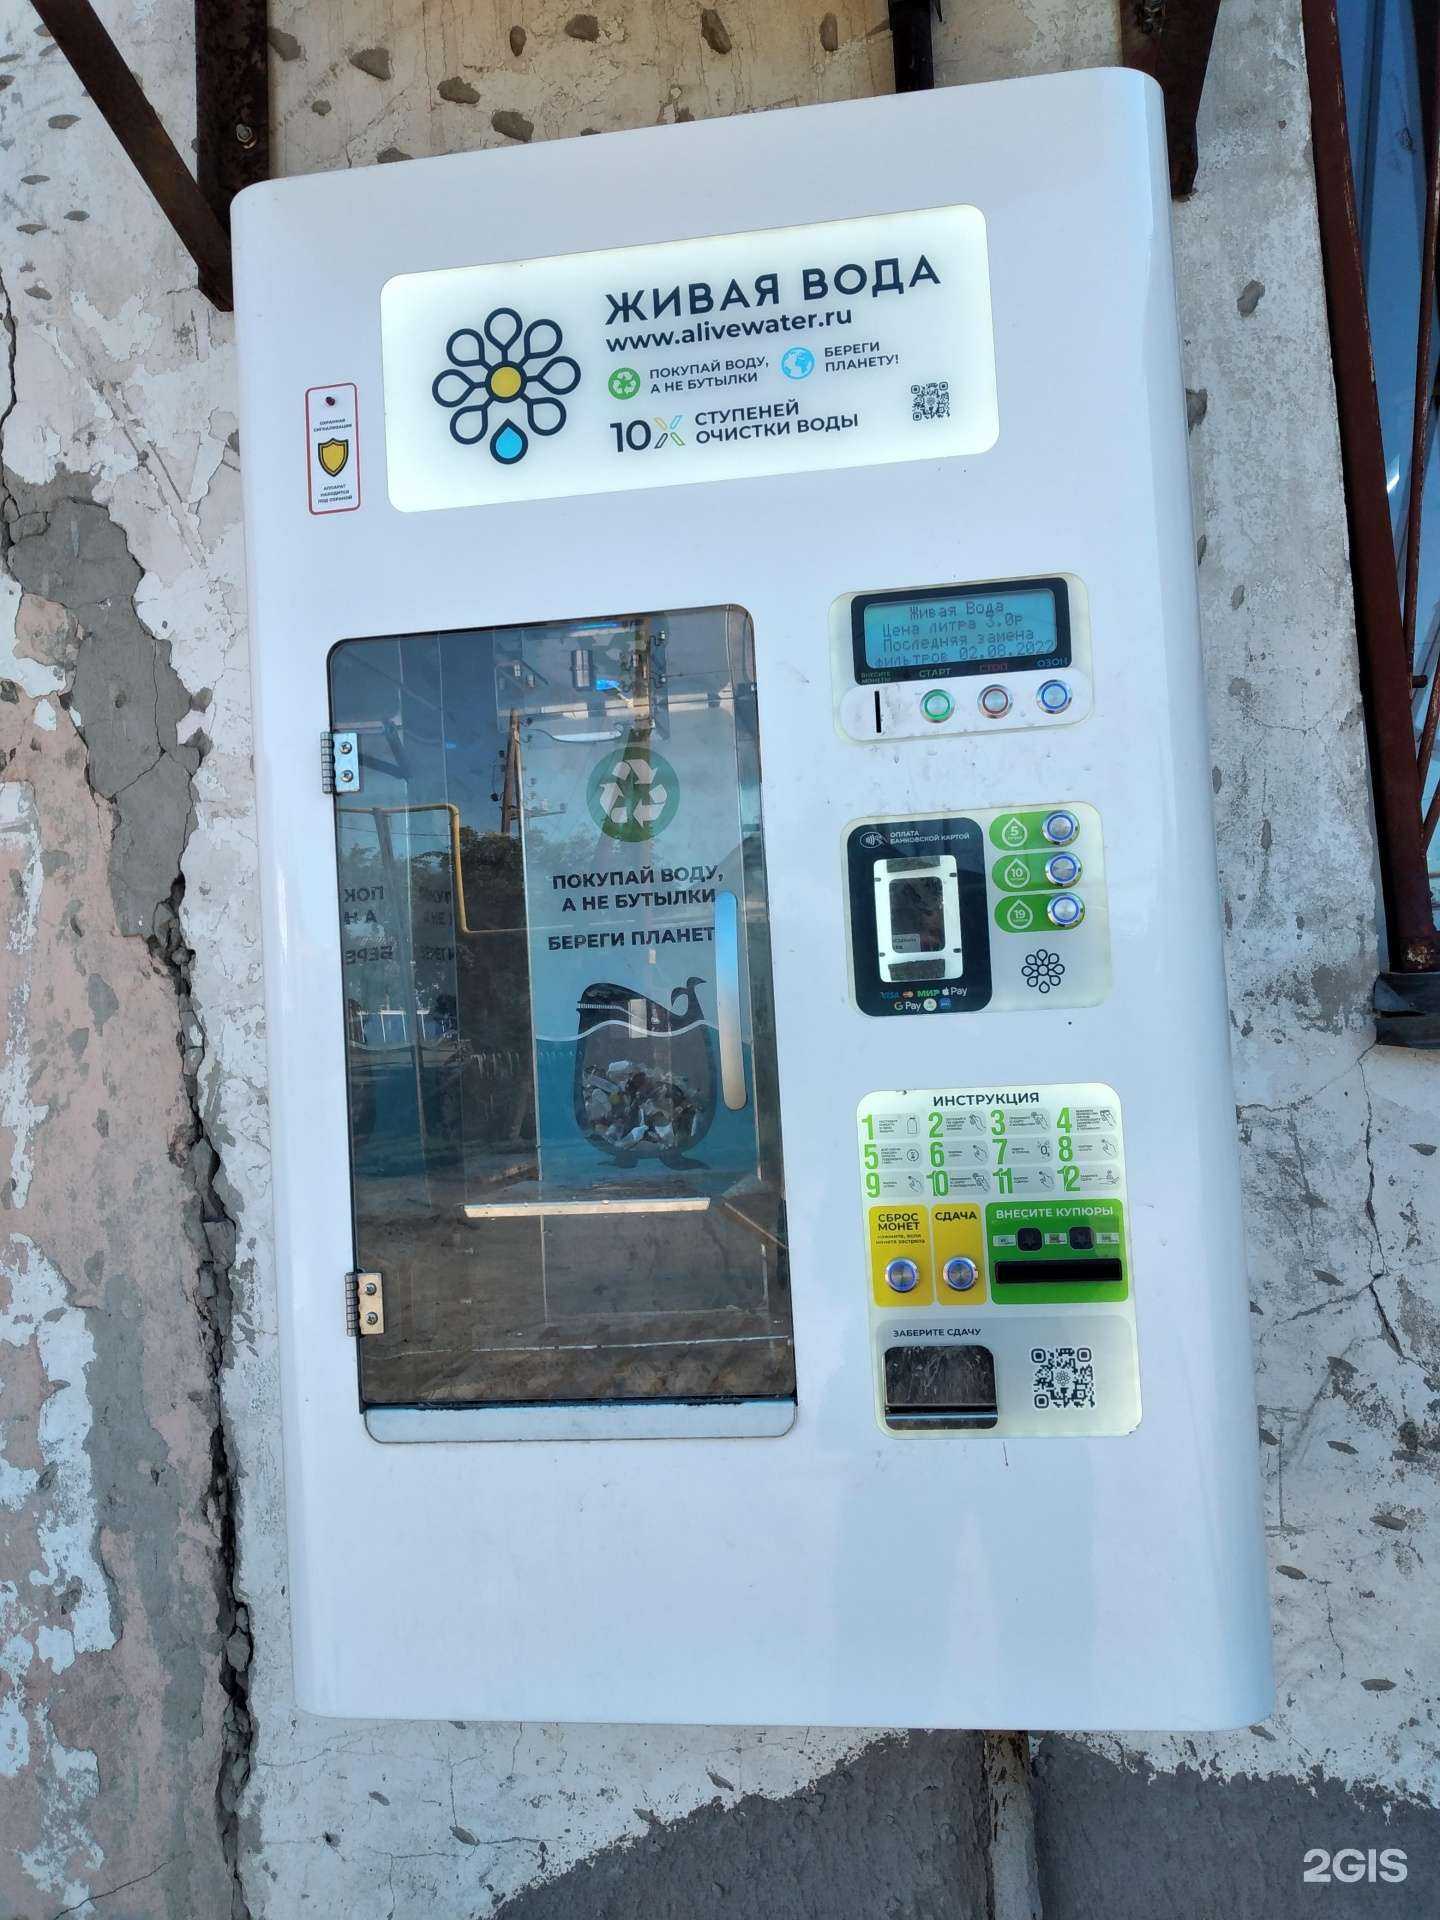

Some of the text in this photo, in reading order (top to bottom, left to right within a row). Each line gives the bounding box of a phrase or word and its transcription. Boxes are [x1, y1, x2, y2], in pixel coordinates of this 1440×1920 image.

[605, 255, 941, 325] ЖИВАЯ ВОДА
[606, 309, 852, 352] www.alivewater.ru
[825, 342, 880, 357] БЕРЕГИ
[650, 356, 769, 379] ПОКУПАЙ ВОДУ,
[825, 354, 899, 372] ПЛАНЕТУ!
[651, 373, 758, 394] А НЕ БУТЫЛКИ
[695, 400, 799, 427] СТУПЕНЕЙ
[696, 413, 859, 444] ОЧИСТКИ ВОДЫ
[909, 601, 1004, 621] Живая Вода
[882, 623, 920, 639] Цена
[929, 618, 977, 634] литра
[883, 629, 1034, 653] Последняя замена
[919, 667, 950, 678] СТАРТ
[979, 662, 1008, 673] СТОП
[1036, 657, 1068, 668] ОЗОН
[890, 830, 920, 838] ОПЛАТА
[890, 832, 970, 845] БАНКОВСКОЙ КАРТОЙ
[1010, 826, 1019, 836] 5
[552, 865, 724, 890] ПОКУПАЙ ВОДУ,
[1011, 868, 1023, 878] 10
[562, 888, 716, 912] А НЕ БУТЫЛКИ
[1013, 909, 1025, 919] 19
[548, 926, 715, 950] БЕРЕГИ ПЛАНЕТ
[917, 989, 940, 997] МИР
[951, 987, 968, 996] Pay
[906, 1001, 921, 1011] Pay
[933, 1092, 1040, 1108] ИНСТРУКЦИЯ
[862, 1115, 874, 1140] 1
[928, 1112, 944, 1138] 2
[991, 1109, 1006, 1135] 3
[1057, 1107, 1072, 1135] 4
[864, 1144, 879, 1169] 5
[930, 1141, 944, 1167] 6
[992, 1138, 1008, 1164] 7
[1059, 1136, 1073, 1162] 8
[866, 1173, 880, 1198] 9
[926, 1170, 949, 1196] 10
[992, 1167, 1013, 1194] 11
[1057, 1165, 1081, 1192] 12
[878, 1213, 918, 1223] СБРОС
[935, 1211, 978, 1222] СДАЧА
[995, 1206, 1114, 1220] ВНЕСИТЕ КУПЮРЫ
[878, 1222, 920, 1232] МОНЕТ
[892, 1328, 981, 1338] ЗАБЕРИТЕ СДАЧУ
